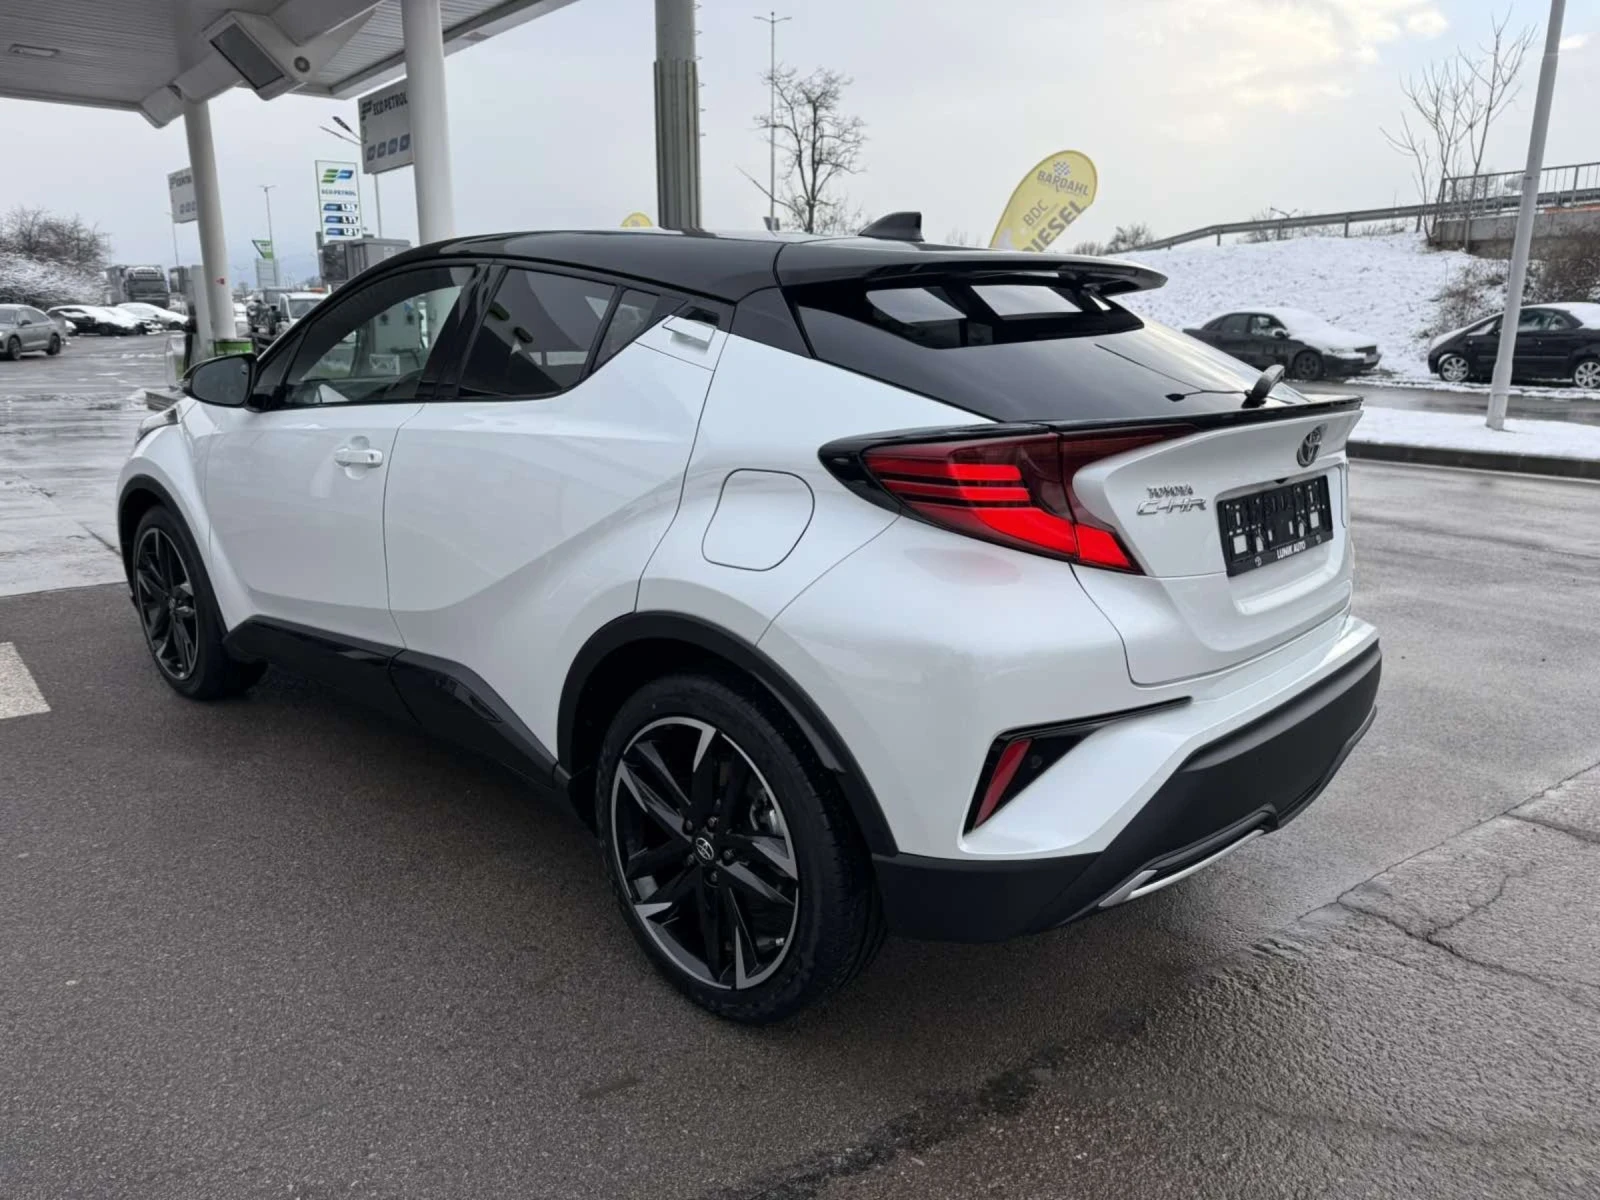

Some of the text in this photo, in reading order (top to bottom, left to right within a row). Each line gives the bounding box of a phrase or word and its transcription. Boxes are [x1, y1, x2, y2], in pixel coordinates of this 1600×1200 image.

[1037, 170, 1088, 196] BARDAHL
[1023, 200, 1048, 226] BDC
[1147, 485, 1193, 498] TOYOTA
[1137, 498, 1206, 516] C-HR
